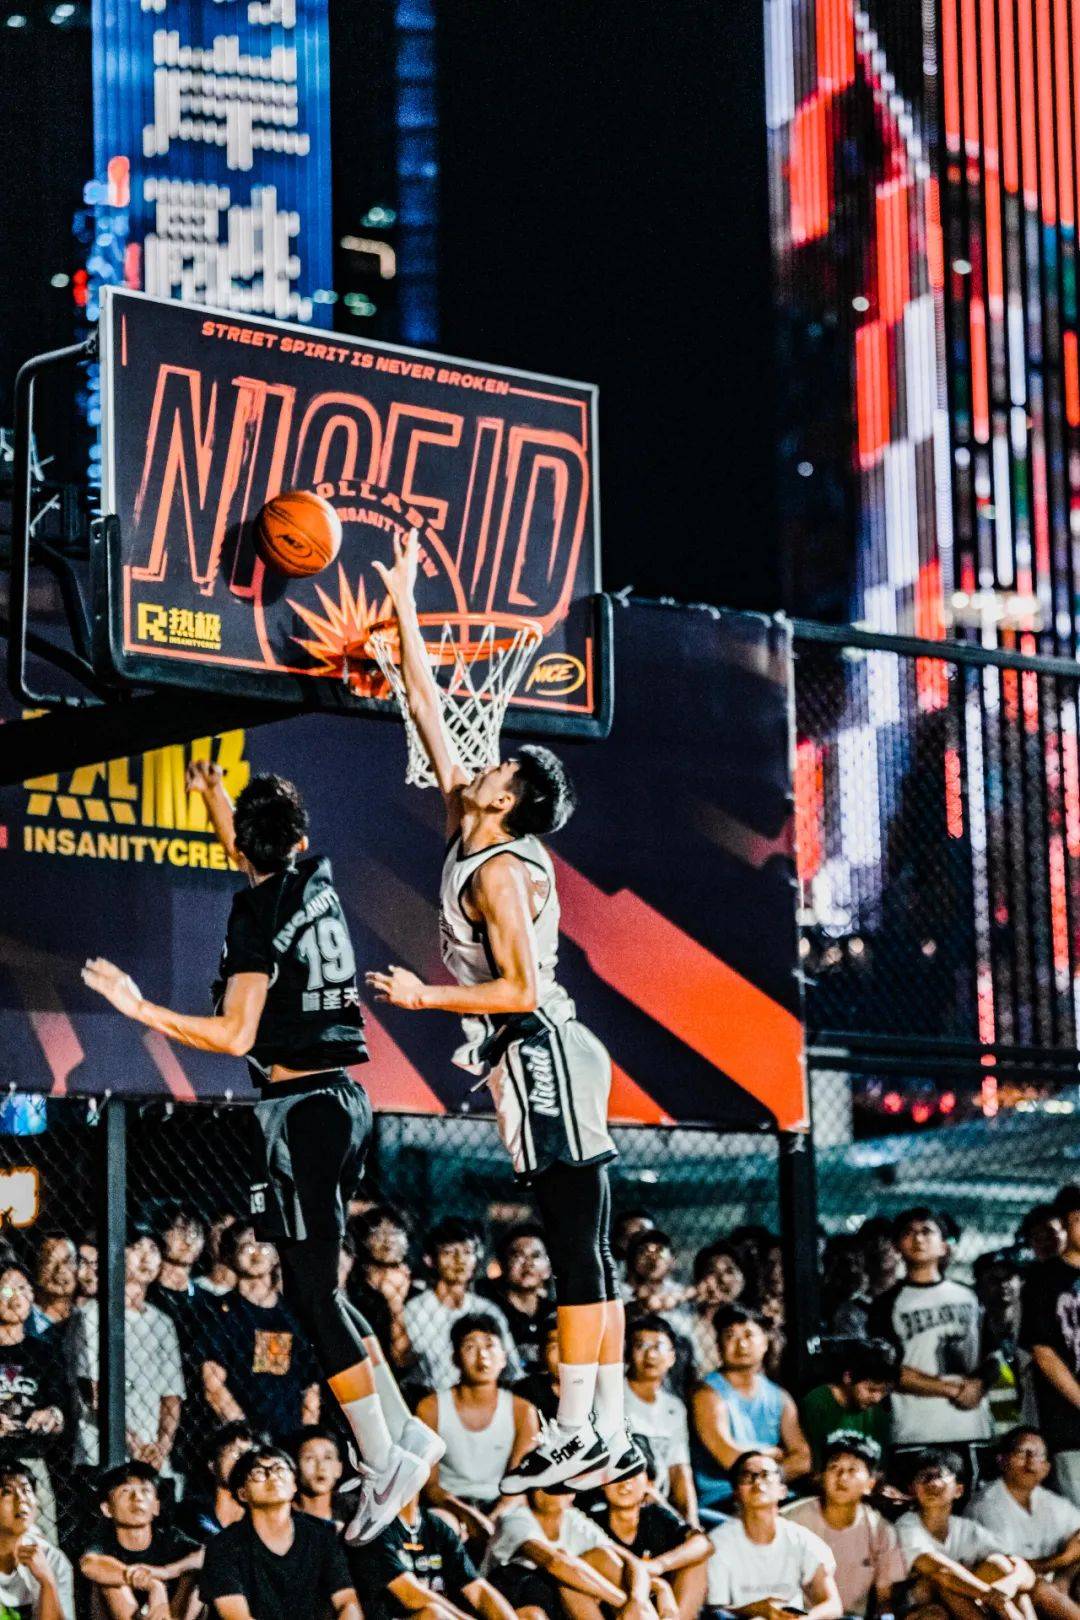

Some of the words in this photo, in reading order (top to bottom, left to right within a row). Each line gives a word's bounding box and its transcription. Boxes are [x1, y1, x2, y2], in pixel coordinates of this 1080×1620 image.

[142, 0, 312, 322] 岸融
[201, 320, 278, 349] STREET
[279, 336, 350, 364] SPIRIT
[350, 351, 374, 368] IS
[375, 356, 436, 381] NEVER
[437, 369, 510, 396] BROKEN
[316, 480, 424, 528] OLLAB
[298, 917, 356, 990] 19
